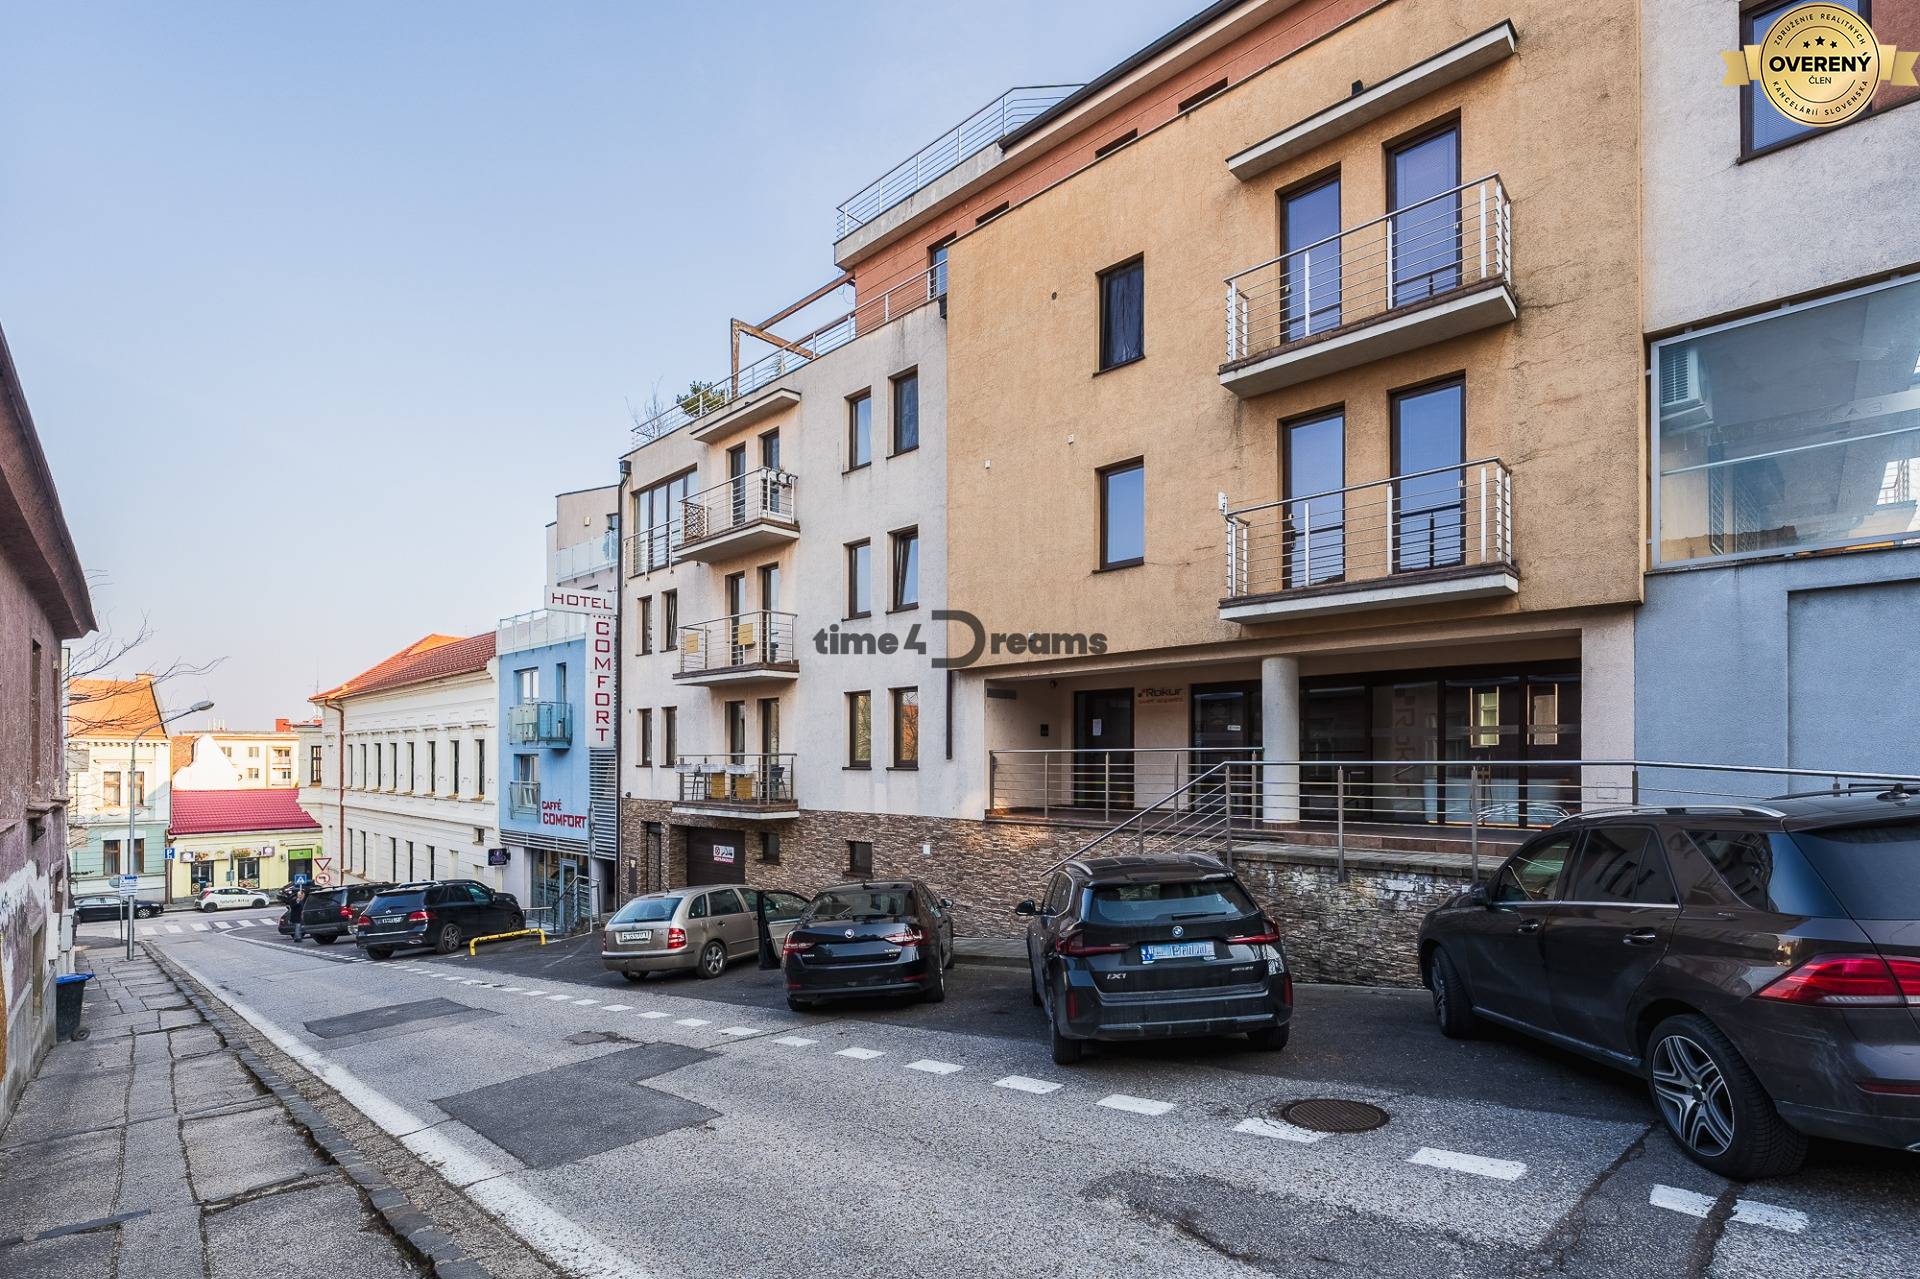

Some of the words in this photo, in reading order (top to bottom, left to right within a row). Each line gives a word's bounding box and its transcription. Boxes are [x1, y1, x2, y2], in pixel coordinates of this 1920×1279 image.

[551, 592, 613, 610] HOTEL
[594, 621, 611, 742] COMFORT
[542, 812, 587, 829] COMFORT
